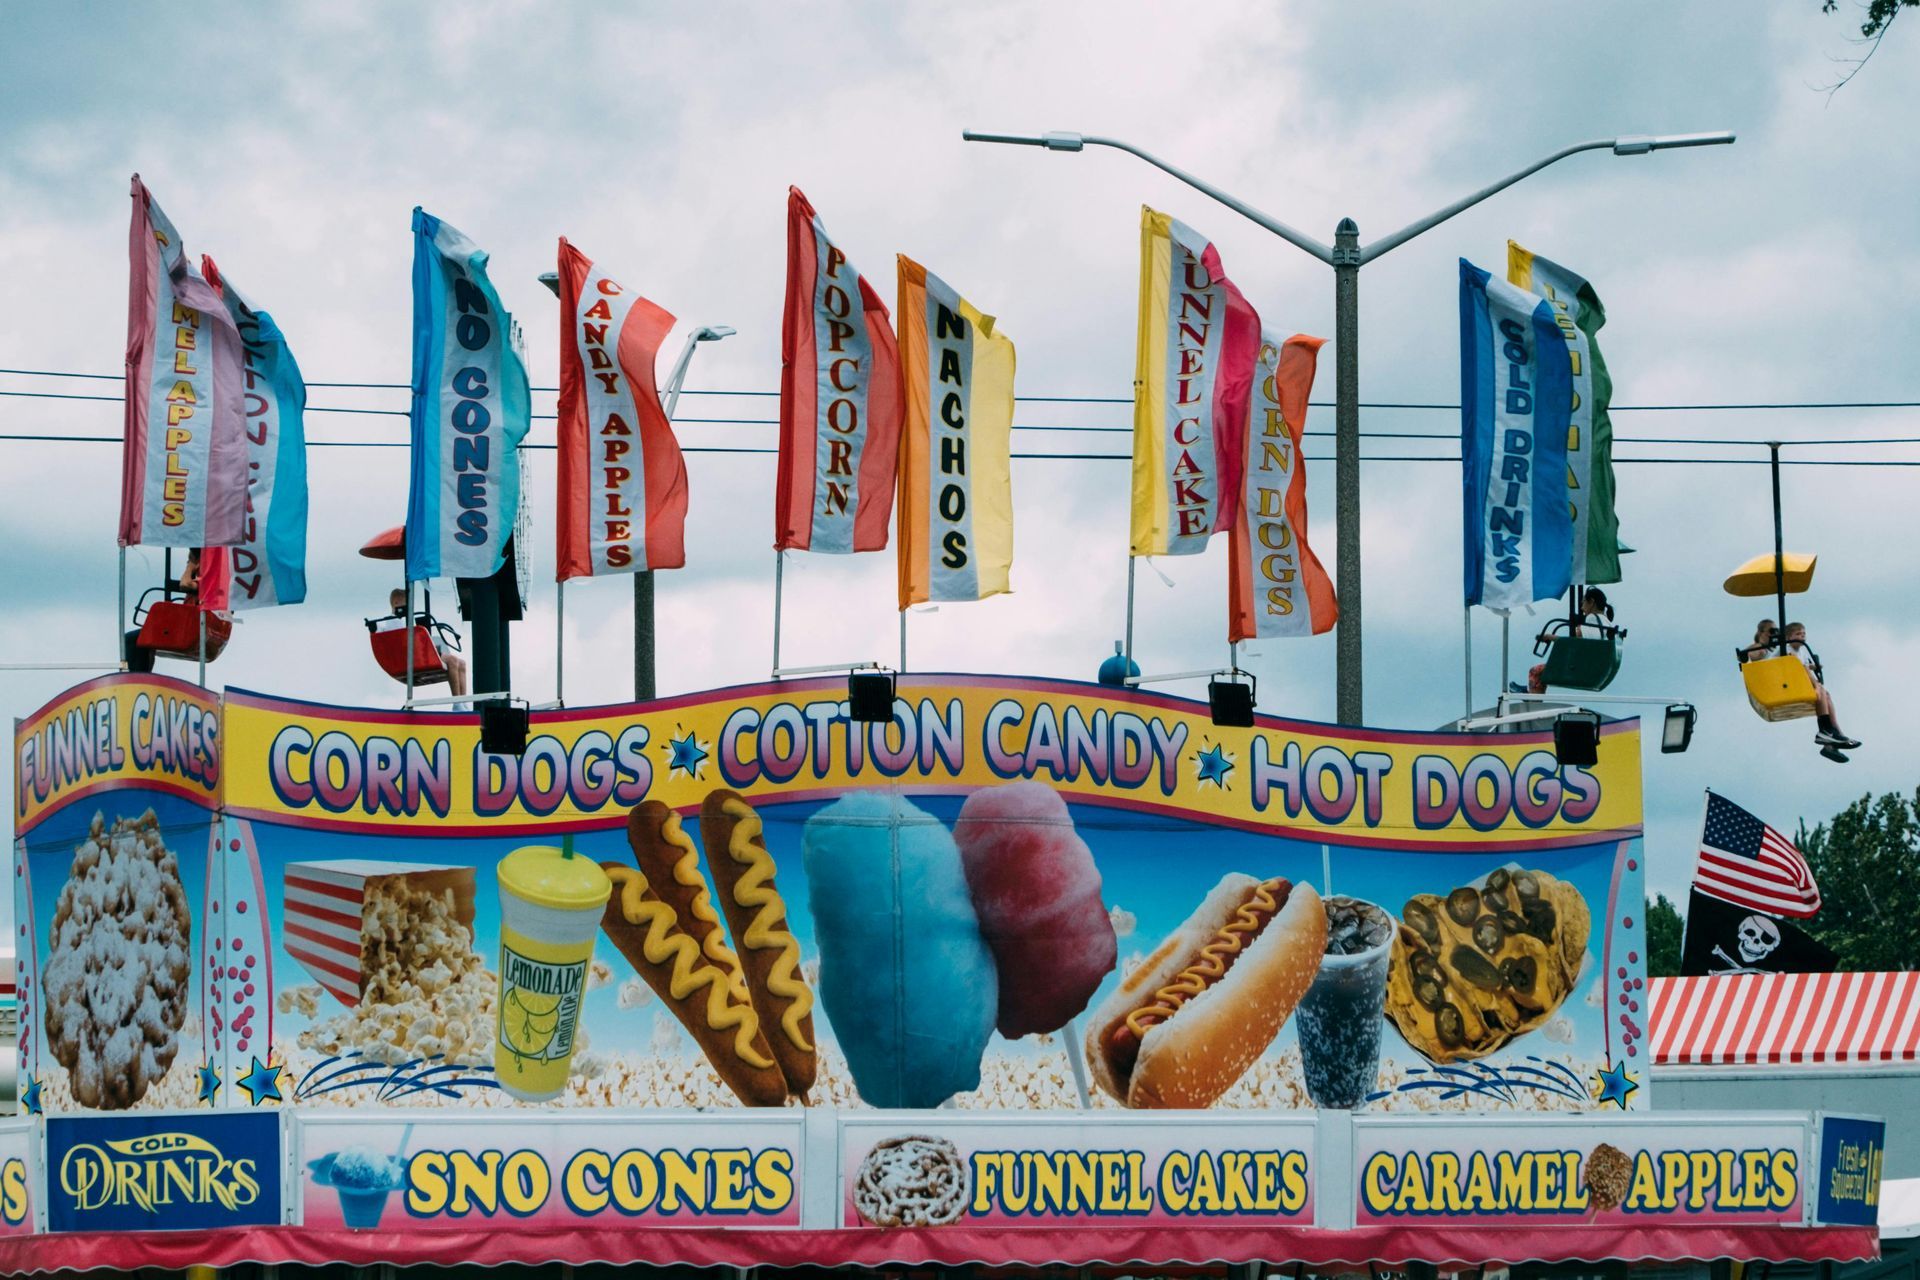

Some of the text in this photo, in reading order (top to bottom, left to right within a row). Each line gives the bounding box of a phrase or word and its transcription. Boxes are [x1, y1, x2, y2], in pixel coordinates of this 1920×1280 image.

[443, 257, 491, 547] NO CONES
[583, 278, 633, 568] CANDY APPLES
[823, 242, 859, 518] POPCORN
[1172, 243, 1216, 538] UNNEL CAKE
[161, 380, 198, 527] APPLES
[936, 303, 968, 570] NACHOS
[1490, 317, 1533, 583] COLD DRINKS
[1256, 487, 1296, 616] DOGS
[19, 692, 219, 816] FUNNEL CAKES
[269, 724, 654, 818] CORN DOGS
[718, 697, 1189, 796] COTTON CANDY
[1251, 735, 1602, 832] HOT DOGS
[60, 1142, 260, 1214] DRINKS
[130, 1136, 188, 1153] COLD
[403, 1148, 795, 1218] SNO CONES
[969, 1150, 1308, 1217] FUNNEL CAKES
[1362, 1149, 1592, 1216] CARAMEL
[1619, 1148, 1798, 1214] APPLES
[1838, 1139, 1860, 1172] Fresh
